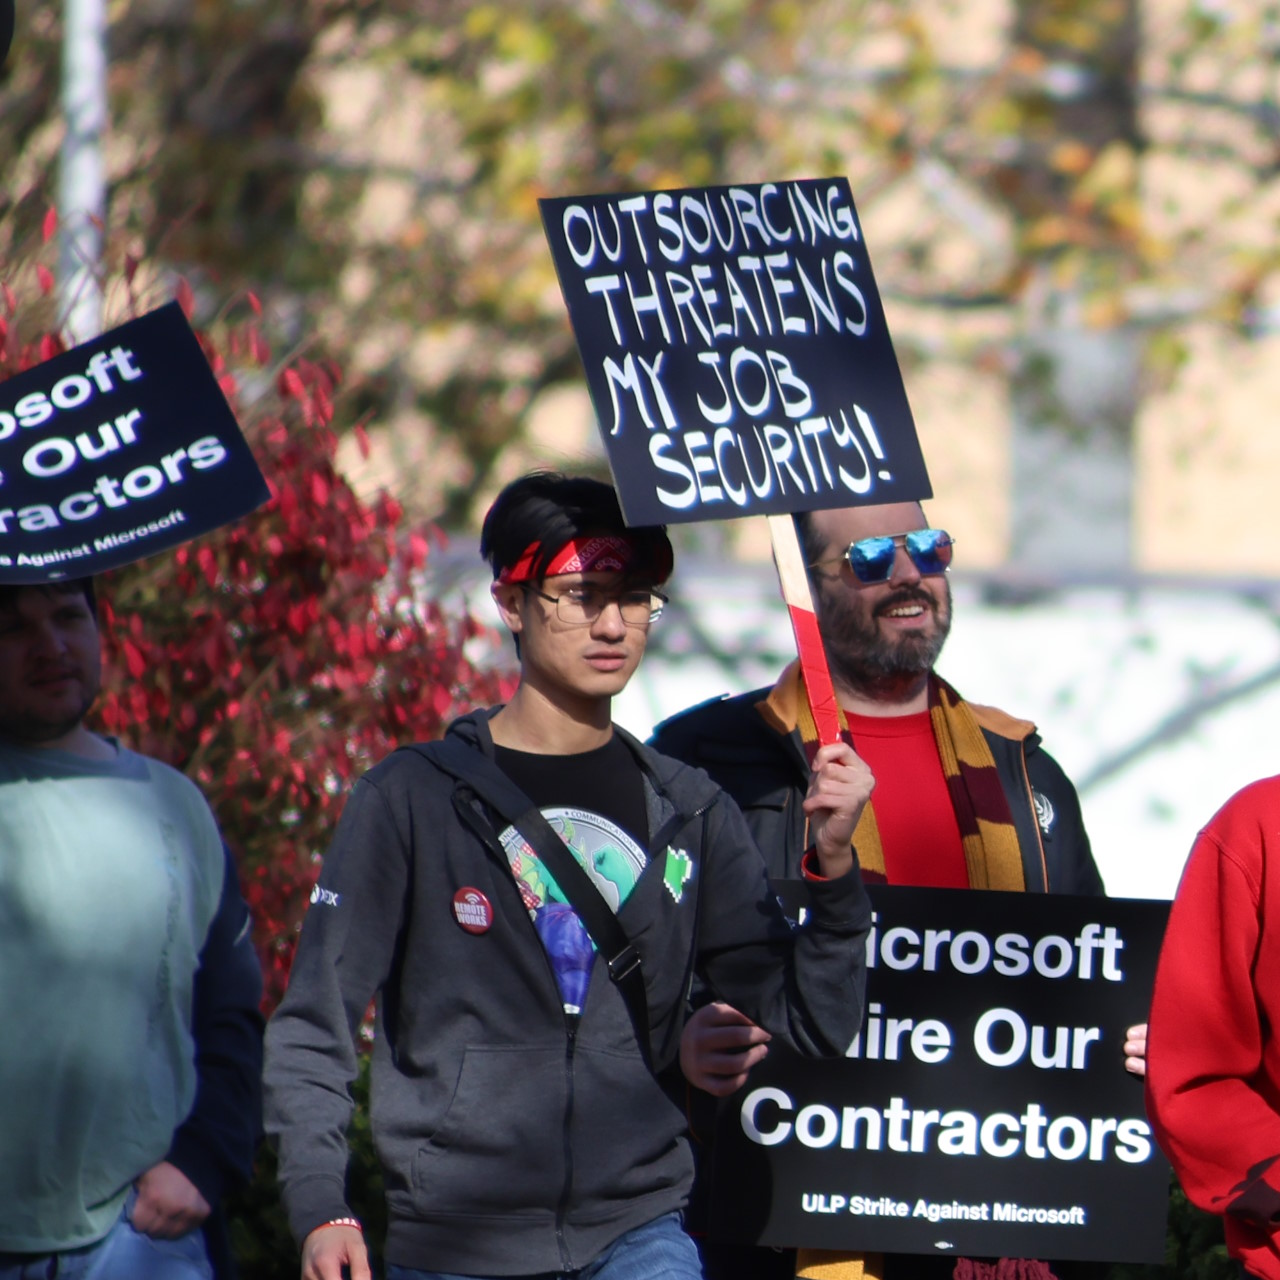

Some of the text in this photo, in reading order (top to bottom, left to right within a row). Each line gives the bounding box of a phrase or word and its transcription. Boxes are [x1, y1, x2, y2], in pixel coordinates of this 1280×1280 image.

[563, 182, 858, 267] OUTSOURCING
[585, 251, 867, 346] THREATENS
[603, 346, 813, 435] MY JOB
[22, 408, 142, 477] Our
[649, 404, 891, 508] SECURITY!
[17, 510, 186, 567] Against Microsoft
[570, 809, 638, 851] COMMUNICATIONS
[454, 901, 486, 916] REMOTE
[456, 913, 488, 926] WORKS
[799, 908, 1124, 981] icrosoft
[846, 1002, 1100, 1069] ire Our
[740, 1087, 1152, 1163] Contractors
[802, 1194, 1085, 1225] ULP Strike Against Microsoft
